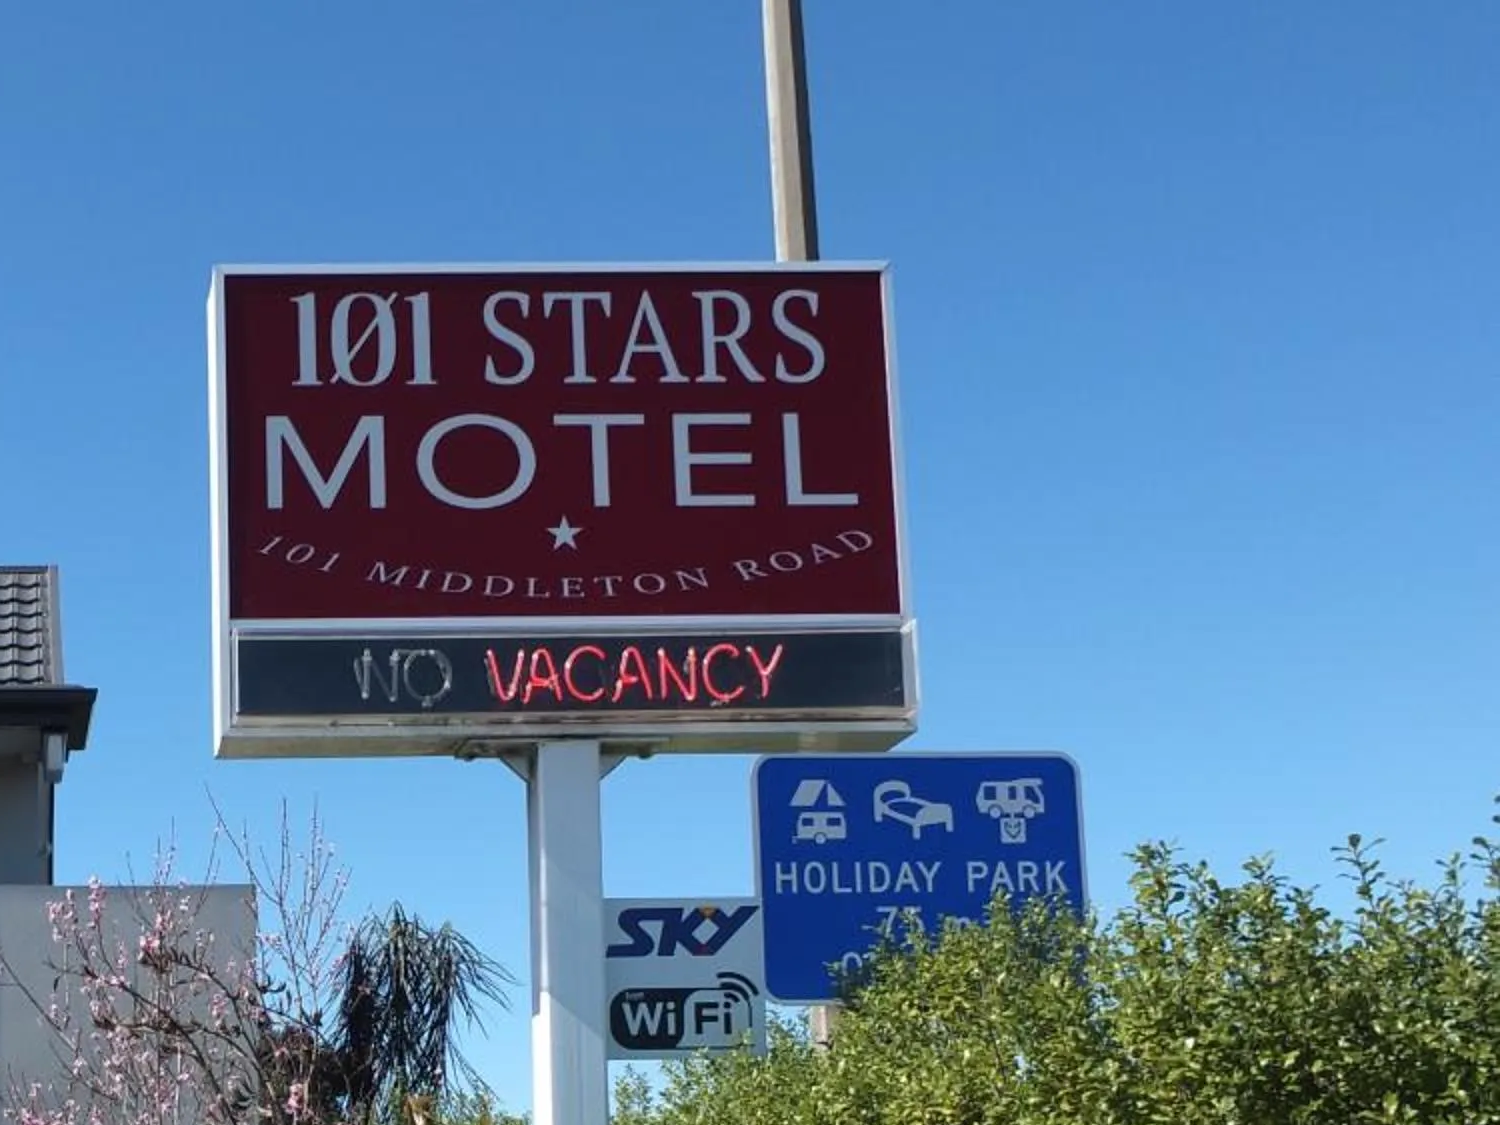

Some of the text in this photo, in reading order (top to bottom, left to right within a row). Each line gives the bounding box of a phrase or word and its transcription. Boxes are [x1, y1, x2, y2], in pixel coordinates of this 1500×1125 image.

[291, 288, 826, 387] 101 STARS
[265, 412, 859, 510] MOTEL
[259, 529, 873, 598] 101 MIDDLETON ROAD
[353, 643, 783, 704] NO VACANCY
[775, 860, 1068, 894] HOLIDAY PARK
[605, 905, 760, 958] SKY
[621, 1001, 732, 1037] WiFi
